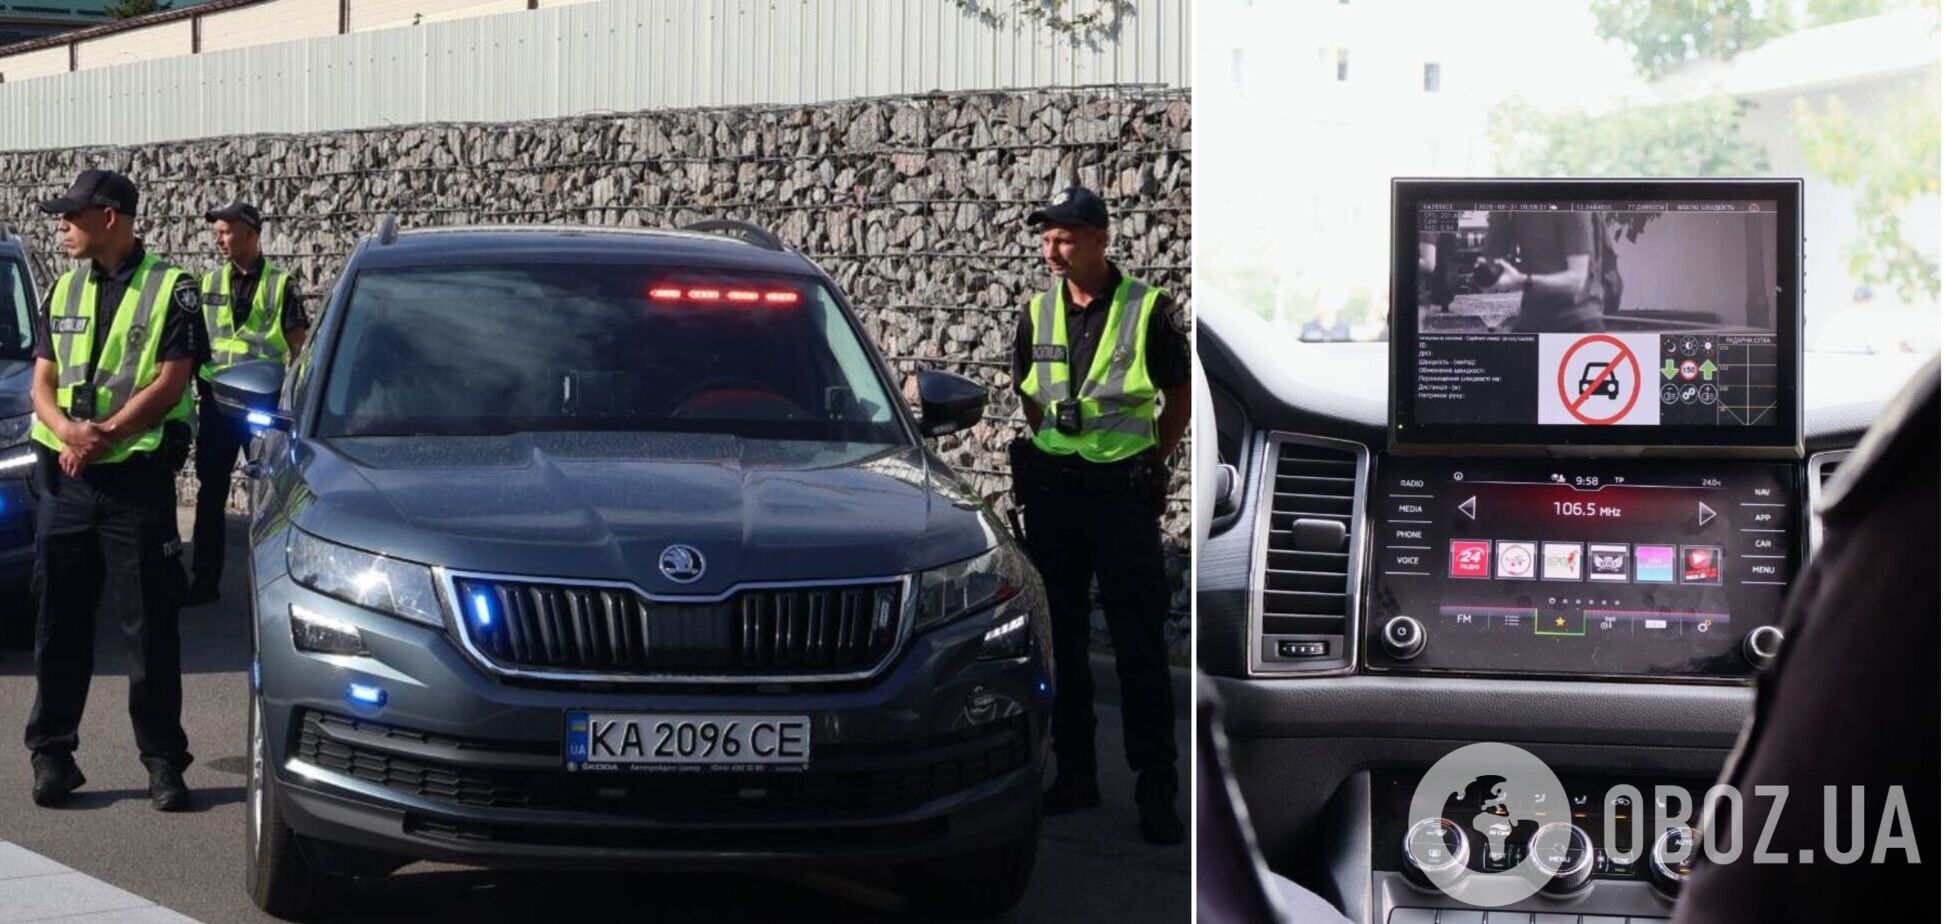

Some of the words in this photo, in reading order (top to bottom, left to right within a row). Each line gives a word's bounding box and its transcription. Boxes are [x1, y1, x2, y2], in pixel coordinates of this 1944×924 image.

[1400, 479, 1424, 487] RADIO
[1575, 477, 1599, 486] 9:58
[1754, 488, 1771, 496] NAV
[1398, 504, 1422, 513] MEDIA
[1553, 502, 1596, 516] 106.5
[1600, 506, 1621, 517] MHz
[1754, 513, 1771, 521] APP
[1396, 530, 1422, 539] PHONE
[1755, 540, 1771, 548] CAR
[1396, 556, 1420, 565] VOICE
[1459, 549, 1482, 563] 24
[1752, 565, 1775, 574] MENU
[1457, 614, 1471, 624] FM
[591, 721, 644, 757] KA
[653, 721, 741, 758] 2096
[750, 722, 804, 758] CE
[570, 744, 586, 756] UA
